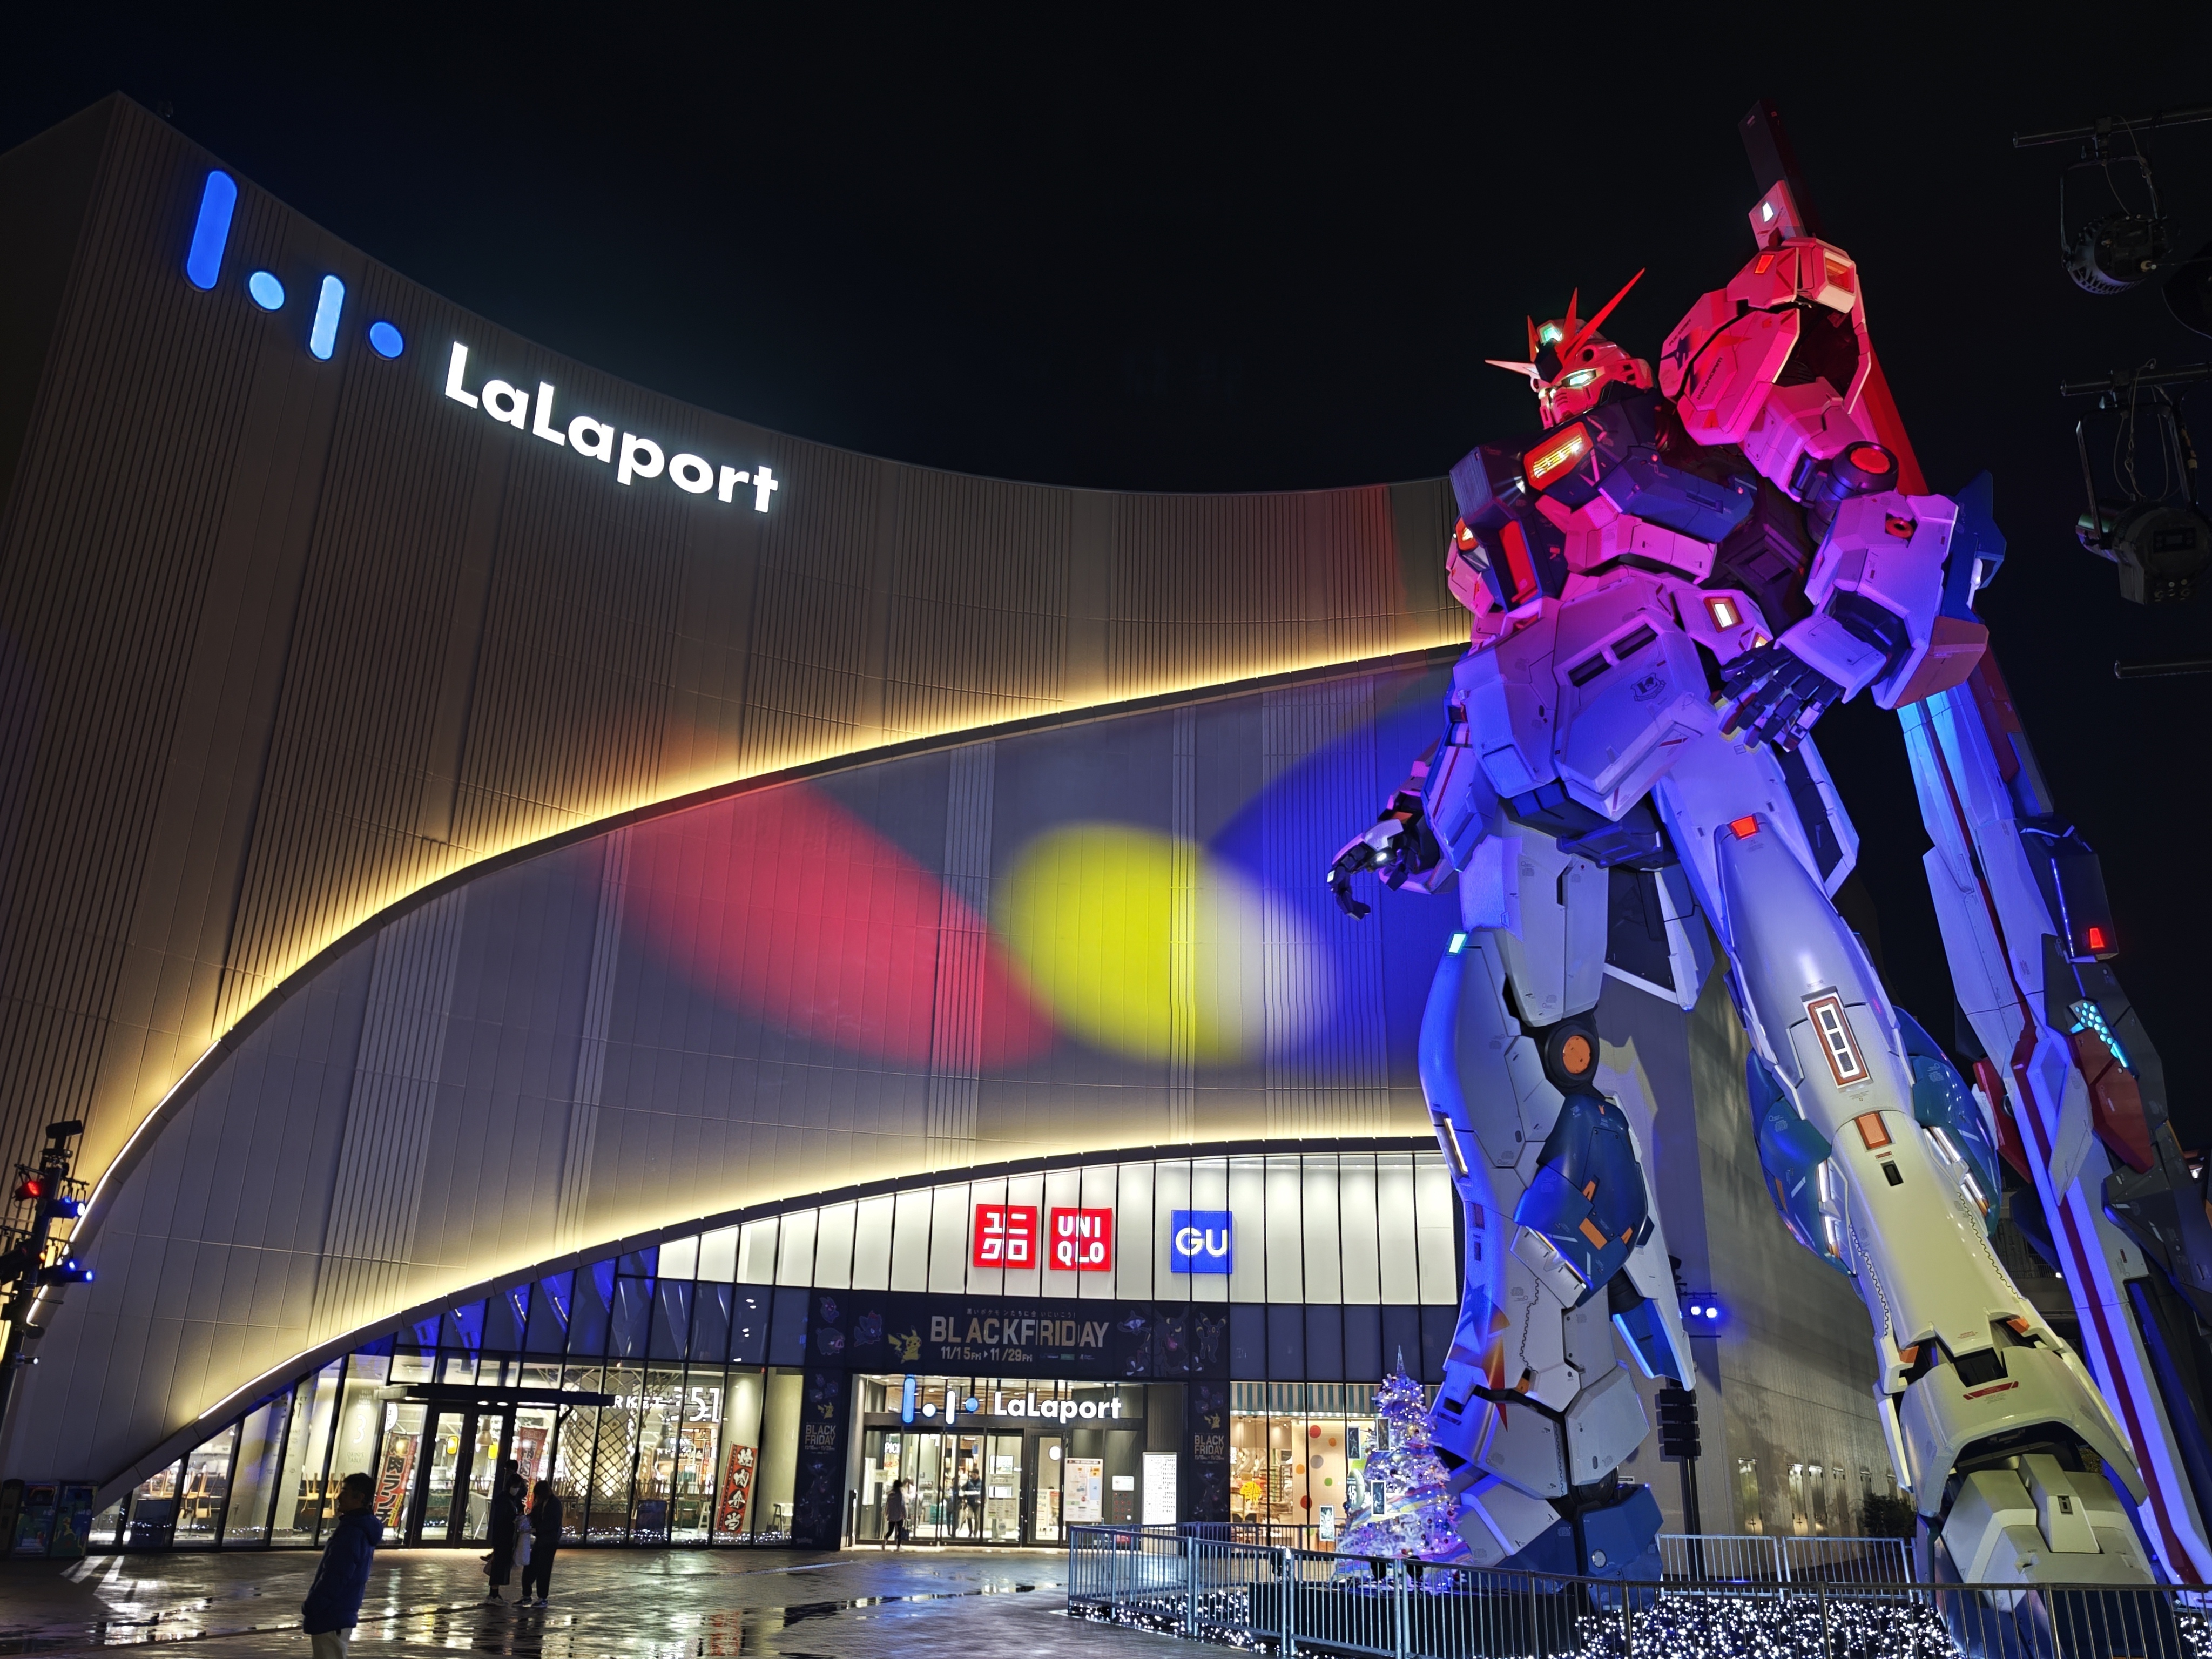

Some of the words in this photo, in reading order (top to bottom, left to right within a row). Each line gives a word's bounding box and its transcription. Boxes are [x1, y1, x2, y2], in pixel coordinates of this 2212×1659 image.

[444, 341, 778, 514] LaLaport
[983, 1212, 1028, 1234] ユニ
[1058, 1215, 1101, 1237] UNI
[981, 1238, 1028, 1260] クロ
[1175, 1227, 1228, 1256] GU
[1057, 1240, 1104, 1266] QLO
[994, 1391, 1122, 1424] LaLaport
[805, 1424, 837, 1435] BLACK
[805, 1434, 836, 1445] FRIDAY
[1194, 1435, 1224, 1445] BLACK
[1194, 1445, 1224, 1455] FRIDAY
[724, 1447, 754, 1531] 焼肉弁当
